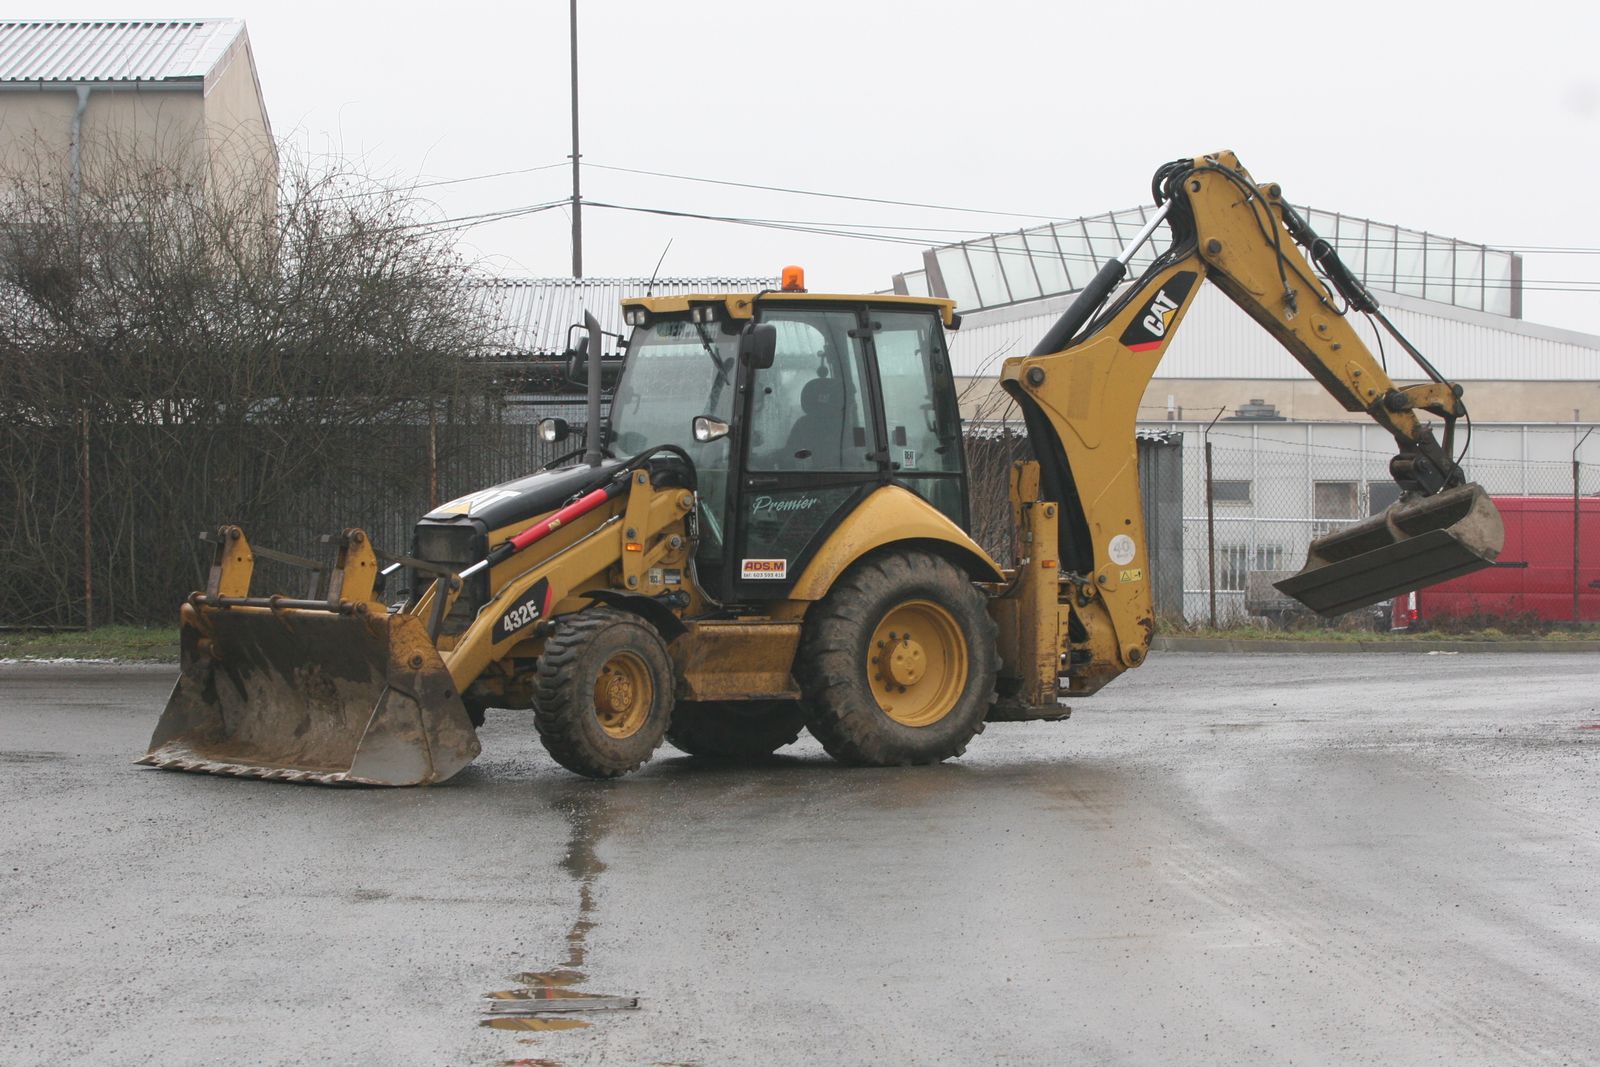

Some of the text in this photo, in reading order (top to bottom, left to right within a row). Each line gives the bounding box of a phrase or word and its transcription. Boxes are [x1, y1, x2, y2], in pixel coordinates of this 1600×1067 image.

[1143, 289, 1179, 337] CAT
[752, 495, 817, 515] Premier
[744, 562, 784, 571] ADS.M
[503, 600, 540, 632] 432E
